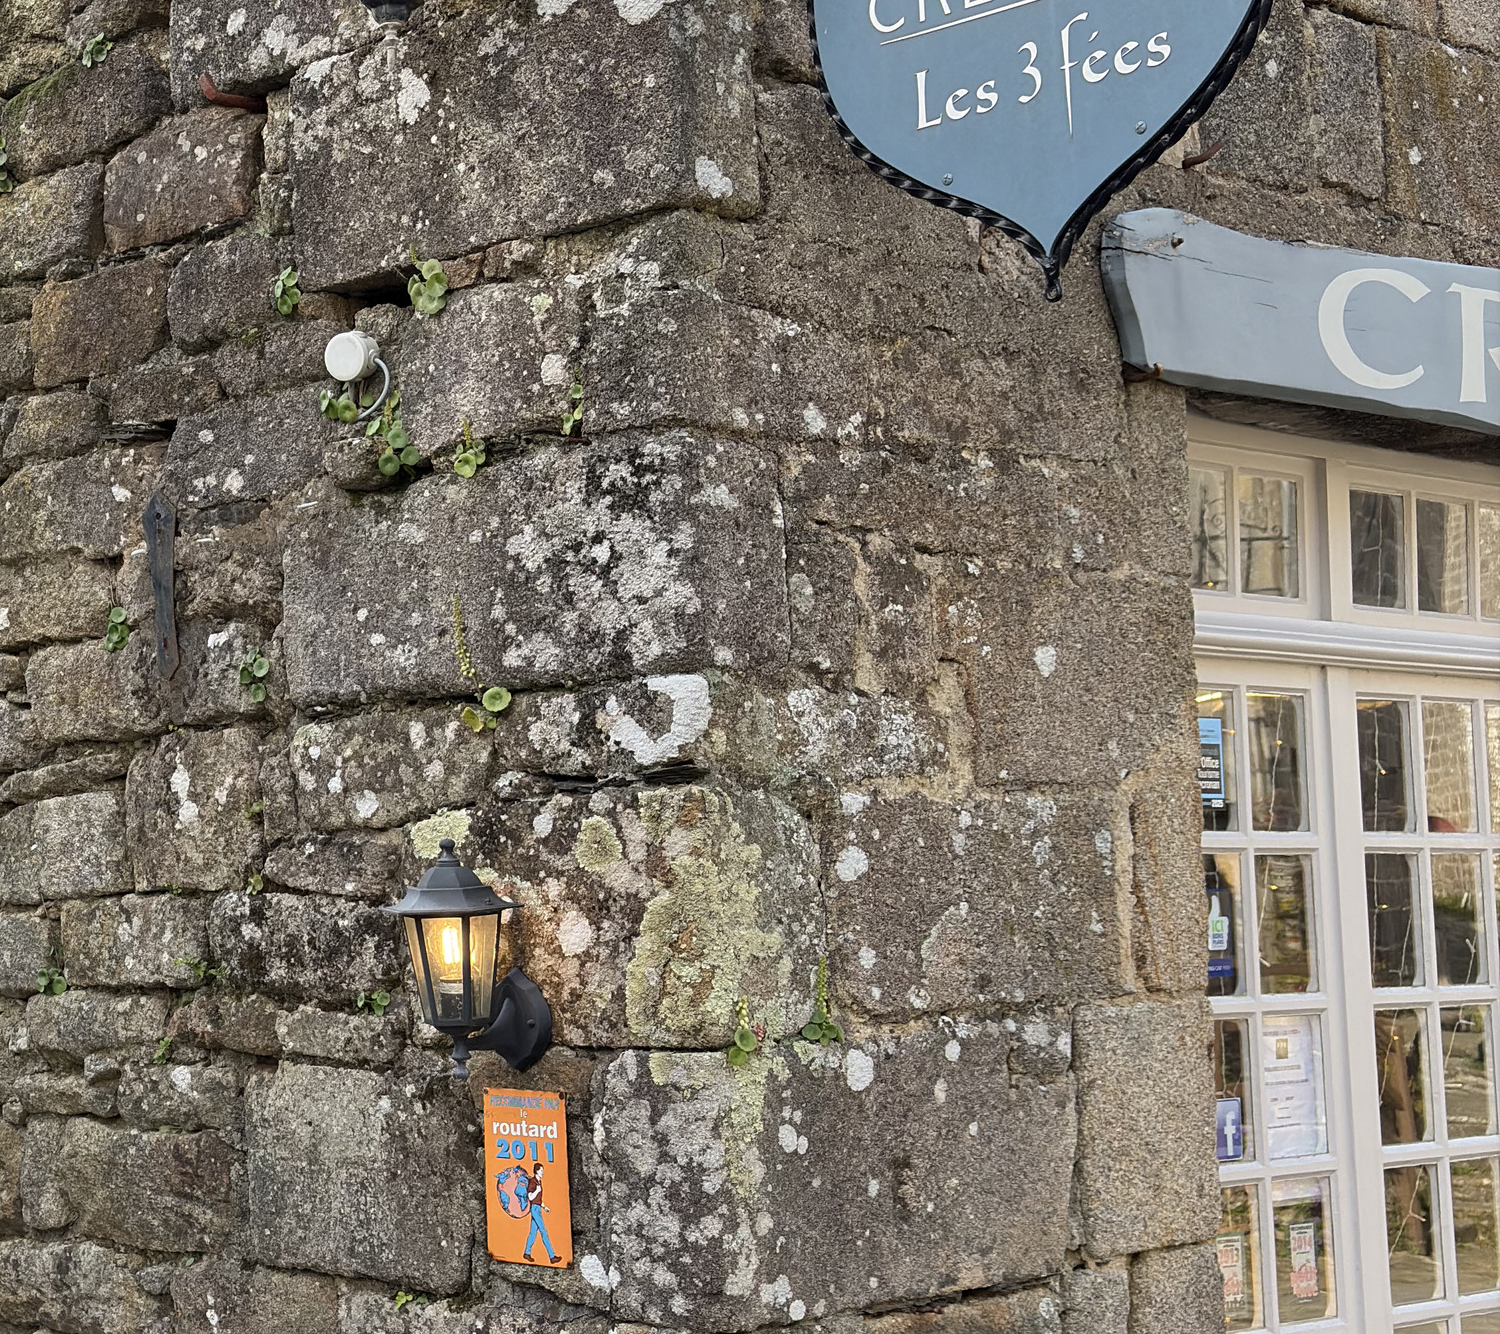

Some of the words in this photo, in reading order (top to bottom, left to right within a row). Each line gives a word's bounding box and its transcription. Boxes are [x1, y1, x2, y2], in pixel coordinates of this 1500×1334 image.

[913, 68, 1000, 130] Les
[1016, 40, 1043, 105] 3
[1059, 11, 1173, 139] fées
[1211, 919, 1224, 933] ICI
[519, 1108, 528, 1118] le
[492, 1120, 559, 1139] routard
[495, 1138, 555, 1163] 2011
